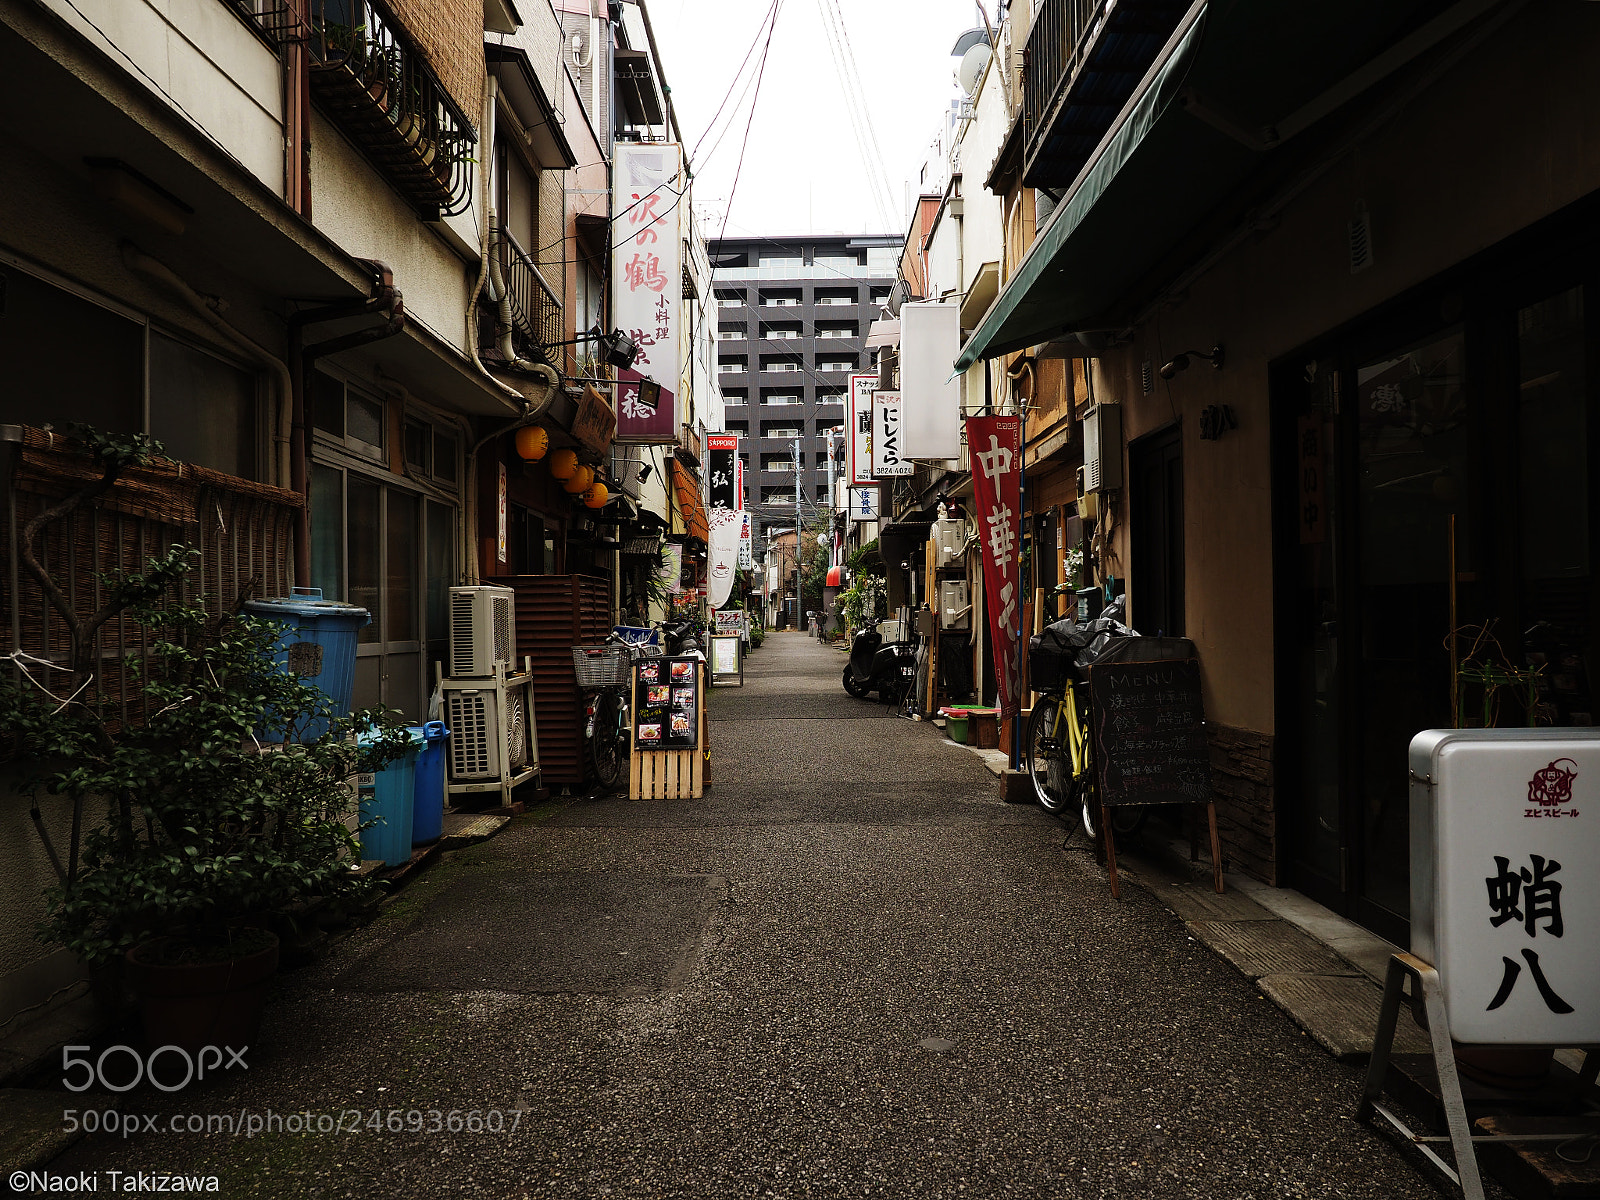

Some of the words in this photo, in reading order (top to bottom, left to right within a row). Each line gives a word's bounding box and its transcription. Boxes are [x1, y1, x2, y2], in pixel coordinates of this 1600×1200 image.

[623, 192, 669, 293] 沢の鶴
[655, 293, 670, 341] 小料理
[883, 407, 899, 466] にしくら
[717, 613, 740, 621] ランチ
[1109, 669, 1174, 689] MENU
[1486, 854, 1575, 1015] 蛸八
